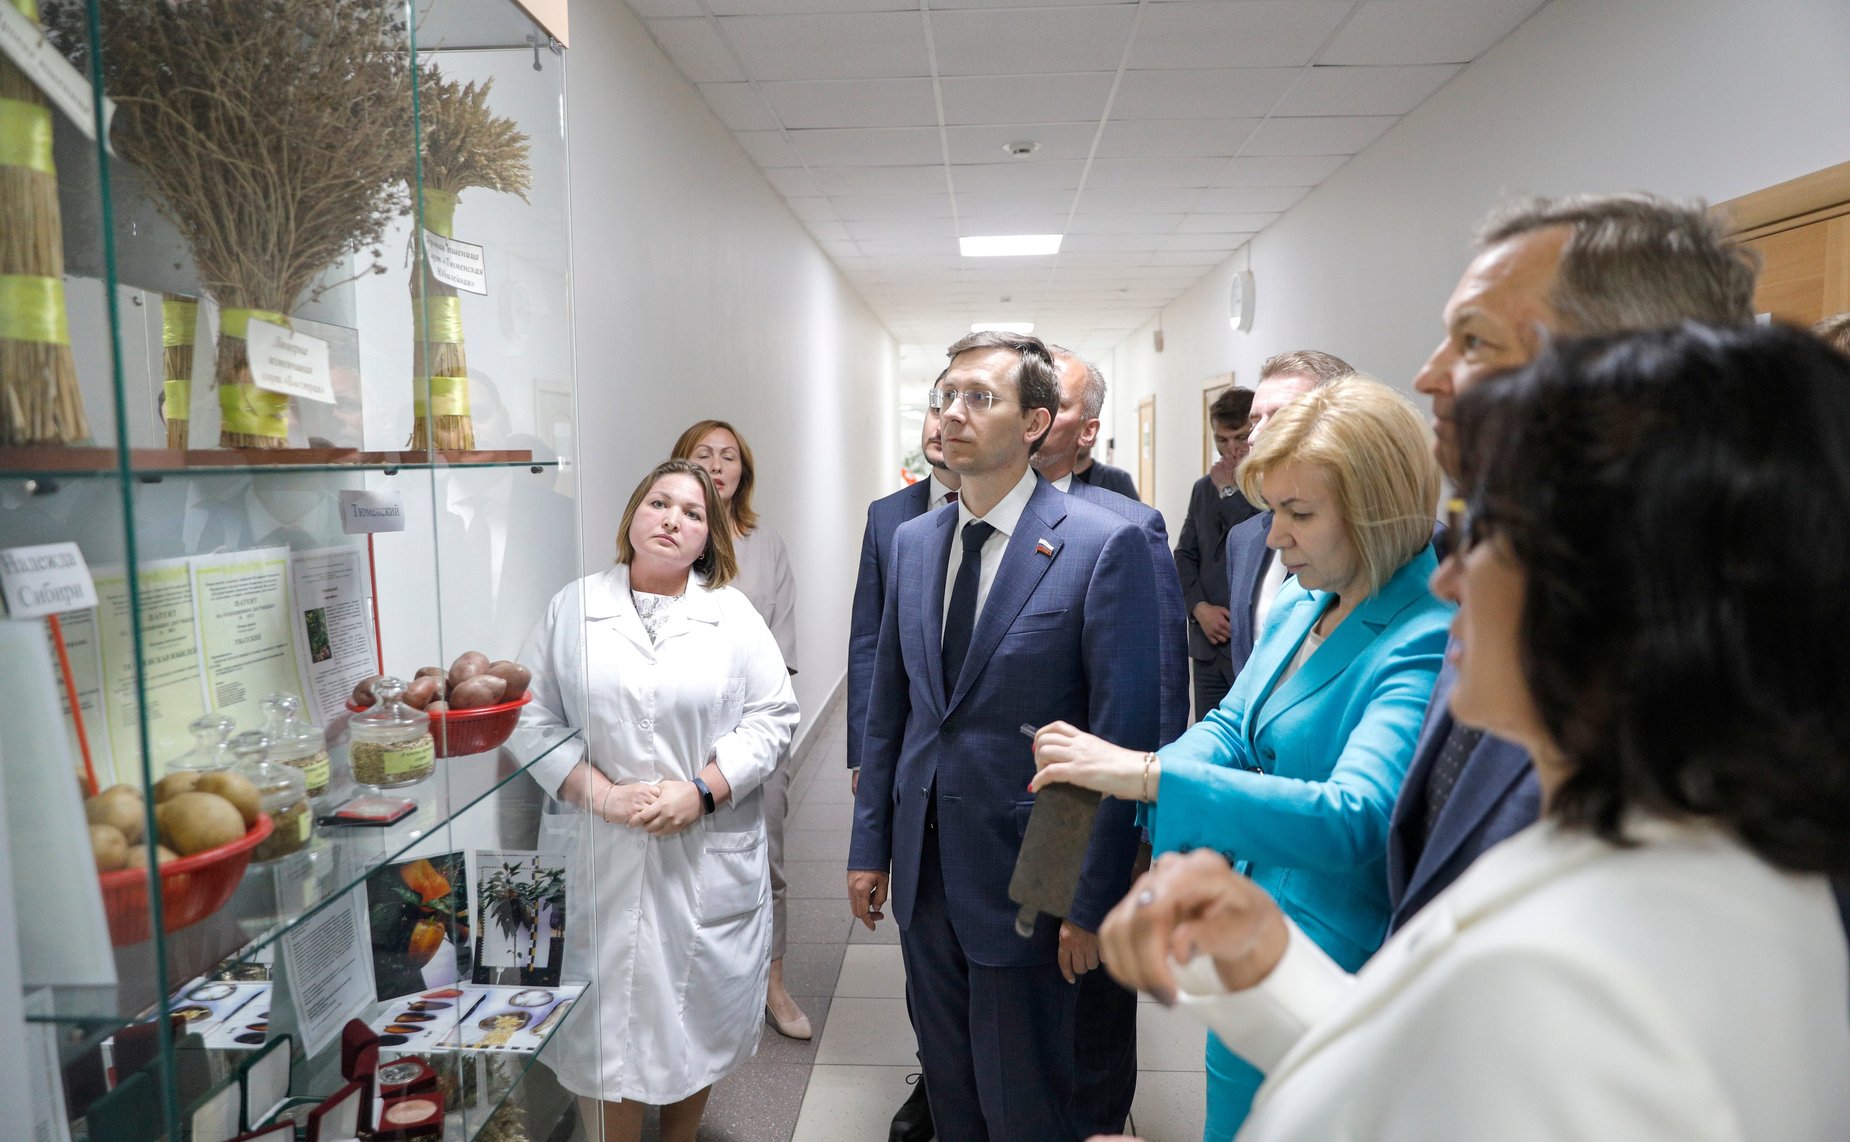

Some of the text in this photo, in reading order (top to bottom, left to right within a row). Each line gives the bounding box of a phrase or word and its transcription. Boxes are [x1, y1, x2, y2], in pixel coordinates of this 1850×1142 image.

[447, 247, 480, 262] пшеница
[351, 504, 400, 518] Тюменский
[0, 552, 77, 575] Надежда
[18, 582, 84, 607] Сибири
